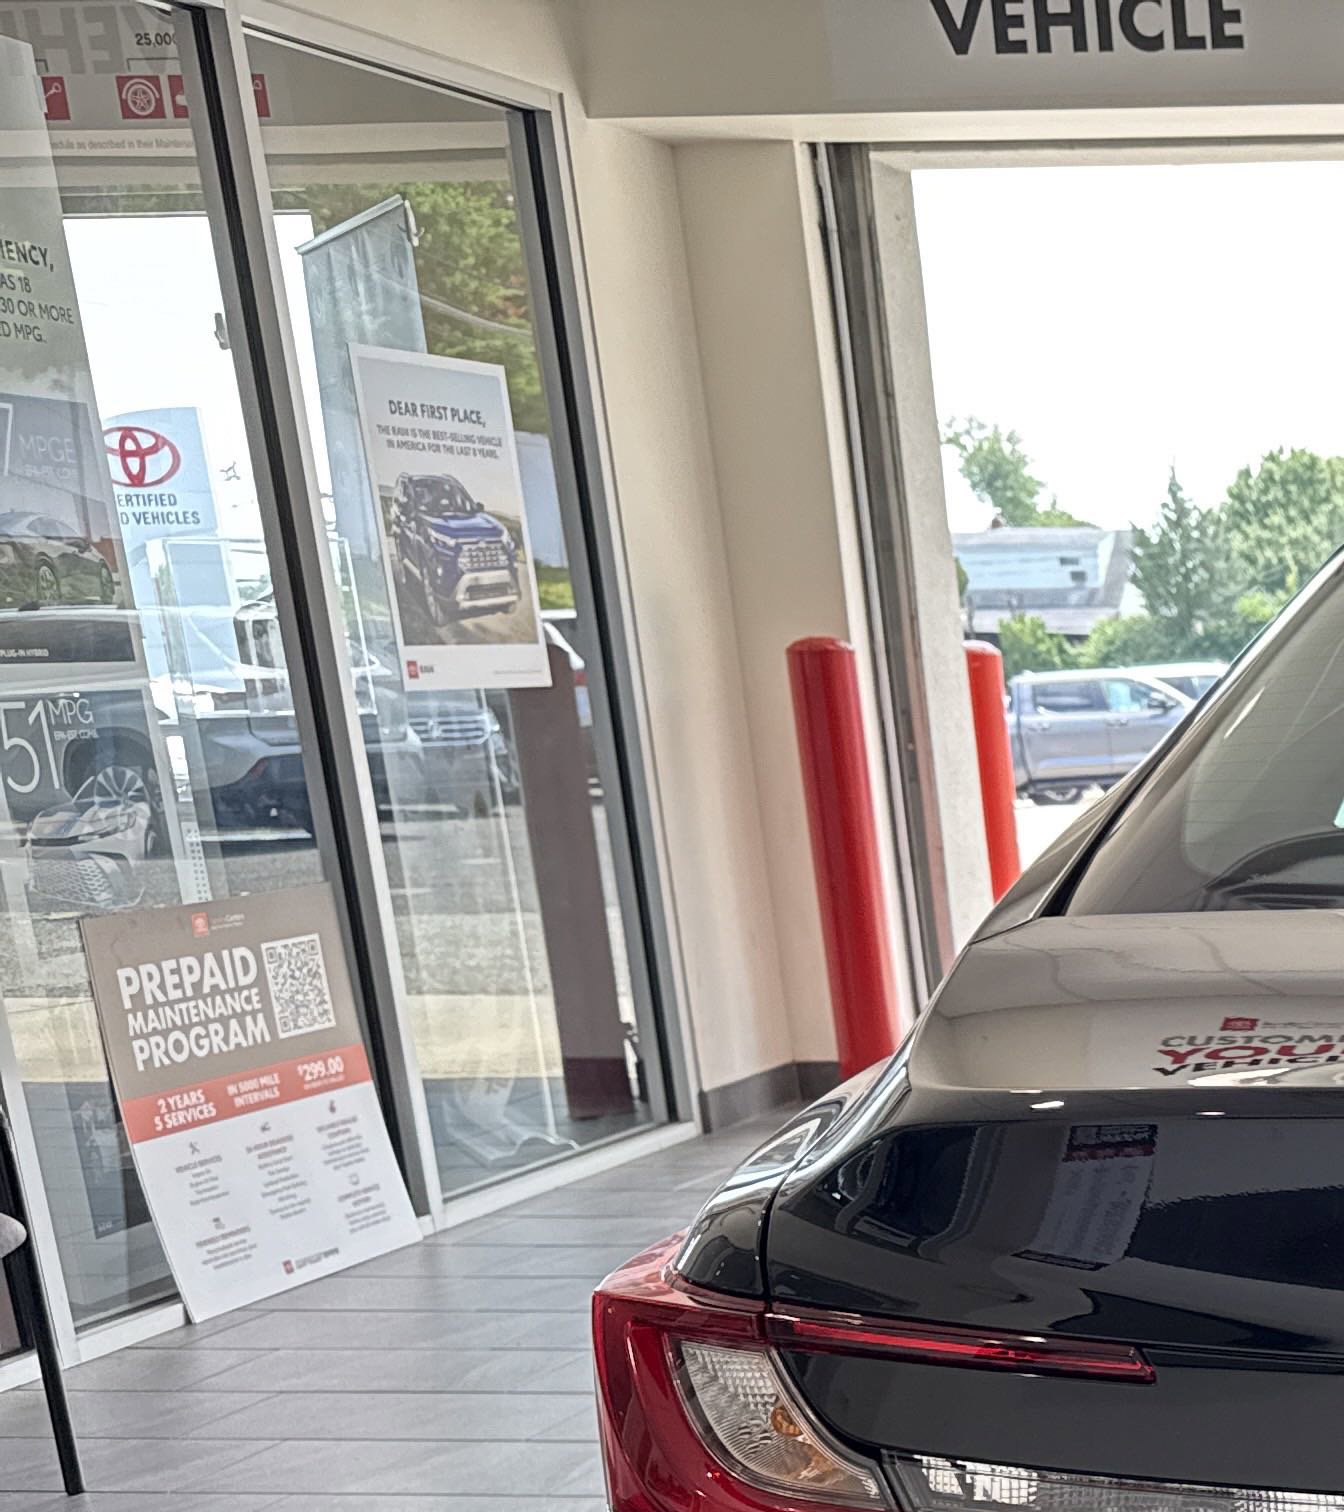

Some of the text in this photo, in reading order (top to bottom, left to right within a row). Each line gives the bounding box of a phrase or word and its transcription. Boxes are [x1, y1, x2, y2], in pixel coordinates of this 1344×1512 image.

[135, 32, 176, 47] 25,00
[931, 0, 1244, 56] VEHICLE
[18, 276, 32, 294] 18
[17, 300, 37, 319] OR
[39, 304, 75, 324] MORE
[388, 399, 486, 428] DEAR FIRST PLACE,
[117, 493, 177, 507] ERTIFIED
[132, 511, 201, 526] VEHICLES
[0, 698, 95, 794] 51 MPG
[116, 946, 259, 1009] PREPAID
[127, 987, 263, 1037] MAINTENANCE
[132, 1013, 271, 1073] PROGRAM
[157, 1089, 206, 1114] 2 YEARS
[165, 1101, 217, 1129] SERVICES
